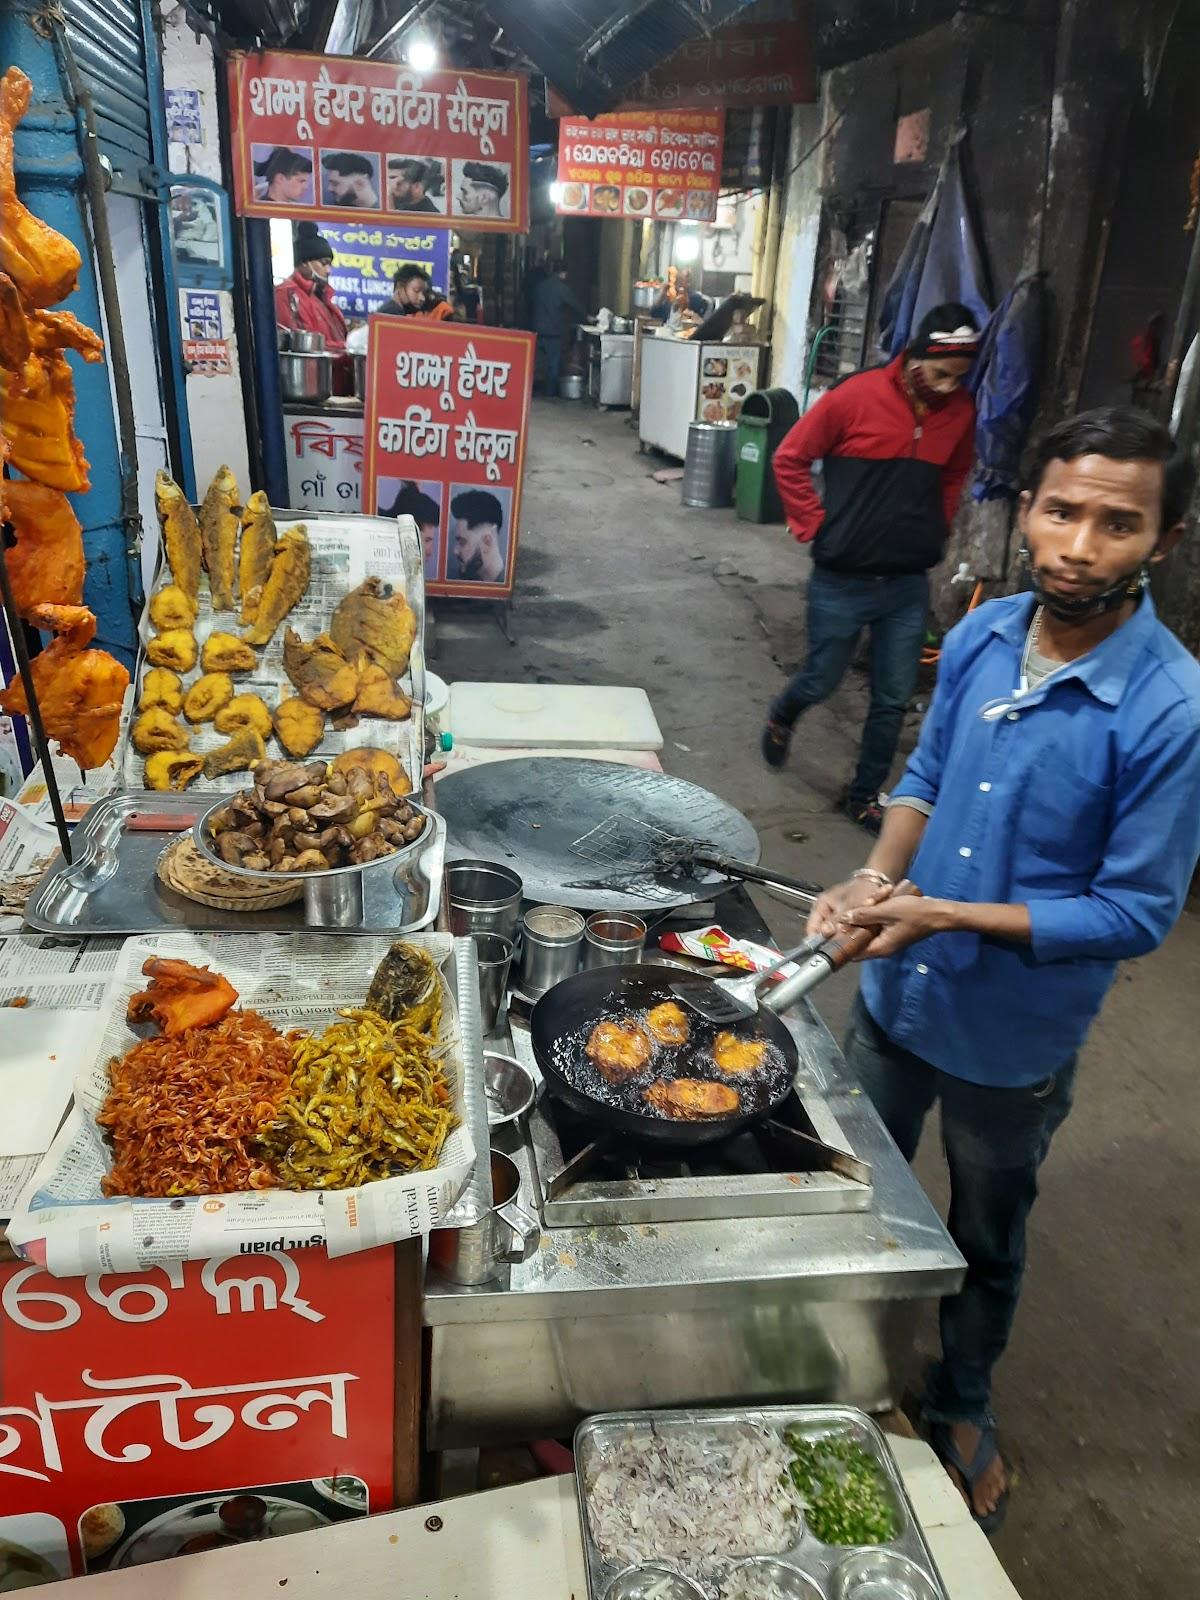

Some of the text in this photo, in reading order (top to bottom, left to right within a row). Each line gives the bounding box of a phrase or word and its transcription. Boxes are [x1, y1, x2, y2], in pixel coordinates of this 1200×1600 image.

[249, 76, 313, 140] शम्भू
[313, 64, 367, 126] हैयर
[371, 73, 442, 130] कटिंग
[446, 77, 511, 155] सैलून
[395, 341, 511, 411] शम्भू हैयर
[378, 405, 518, 481] कटिंग सैलून
[345, 1194, 358, 1228] mint
[402, 1186, 421, 1236] revival
